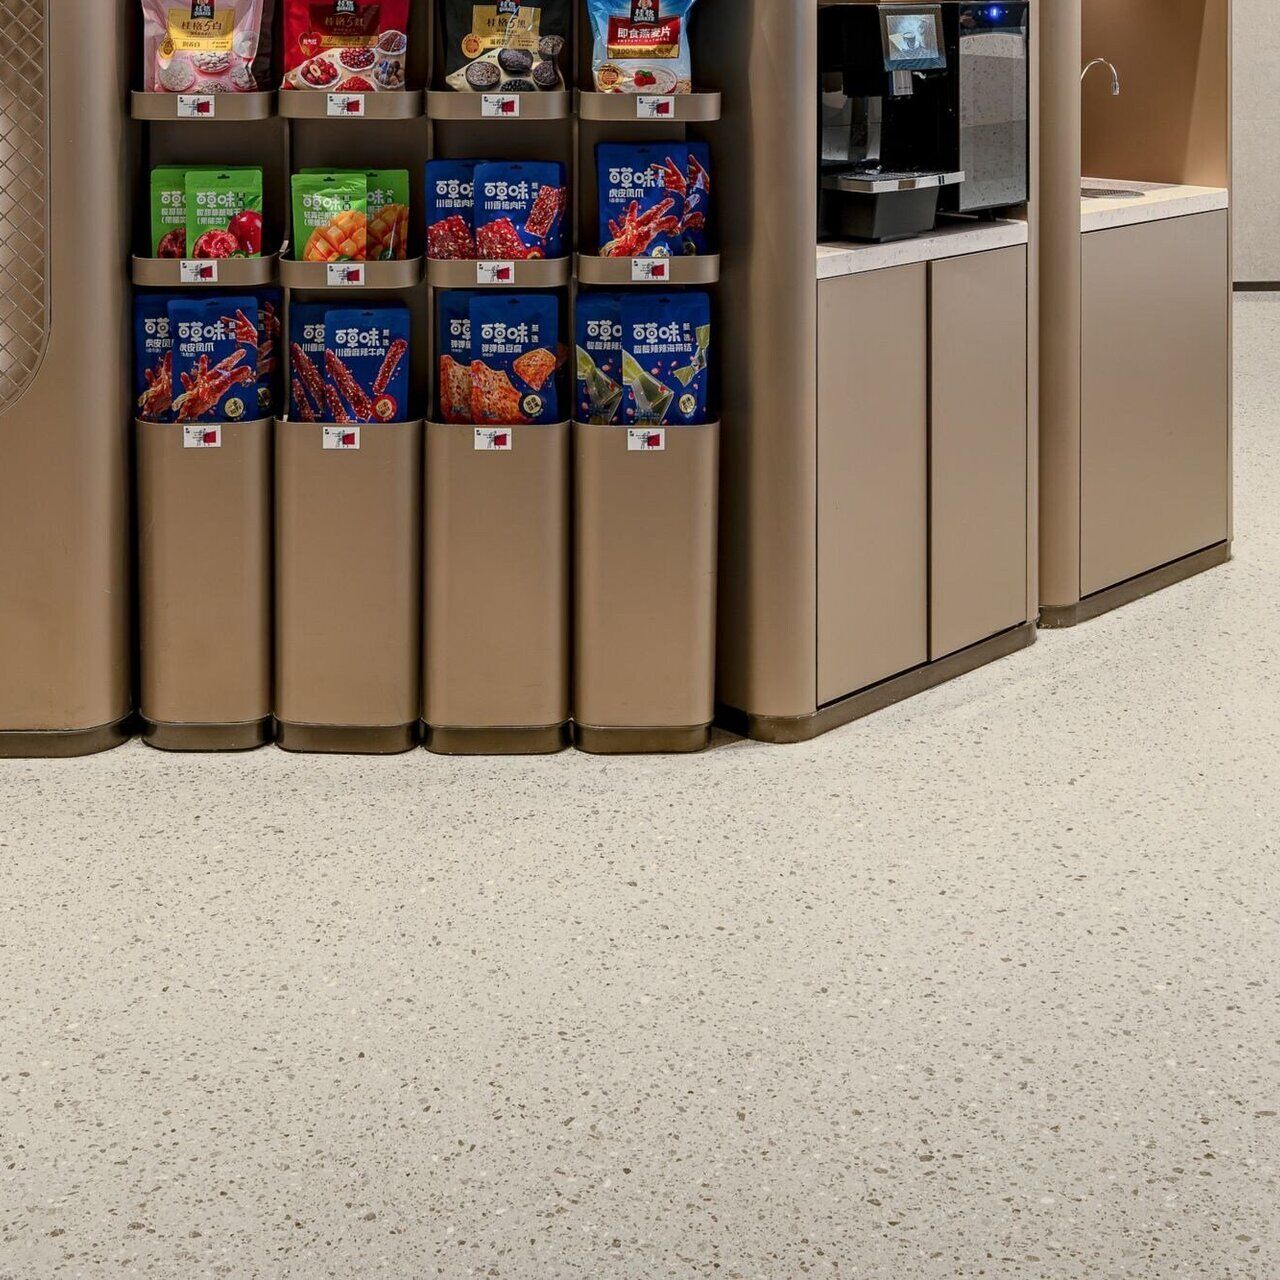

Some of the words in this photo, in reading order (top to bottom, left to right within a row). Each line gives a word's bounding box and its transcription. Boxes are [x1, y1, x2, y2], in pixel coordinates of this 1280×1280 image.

[617, 25, 671, 39] 即食燕麦片
[609, 166, 657, 188] 百草味
[161, 190, 186, 208] 百草
[196, 190, 236, 208] 百草味
[484, 181, 529, 200] 百草味
[609, 188, 644, 198] 虎皮凤爪
[303, 193, 341, 211] 百草味
[484, 201, 526, 210] 川香猪肉片
[178, 321, 226, 342] 百草味
[335, 327, 380, 348] 百草味
[481, 322, 528, 344] 百草味
[633, 322, 681, 344] 百草味
[145, 338, 173, 348] 虎皮凤
[179, 342, 214, 352] 虎皮凤爪
[481, 343, 522, 354] 弹弹鱼豆腐
[586, 341, 622, 351] 酸酸辣辣
[335, 348, 385, 358] 川香麻辣牛肉
